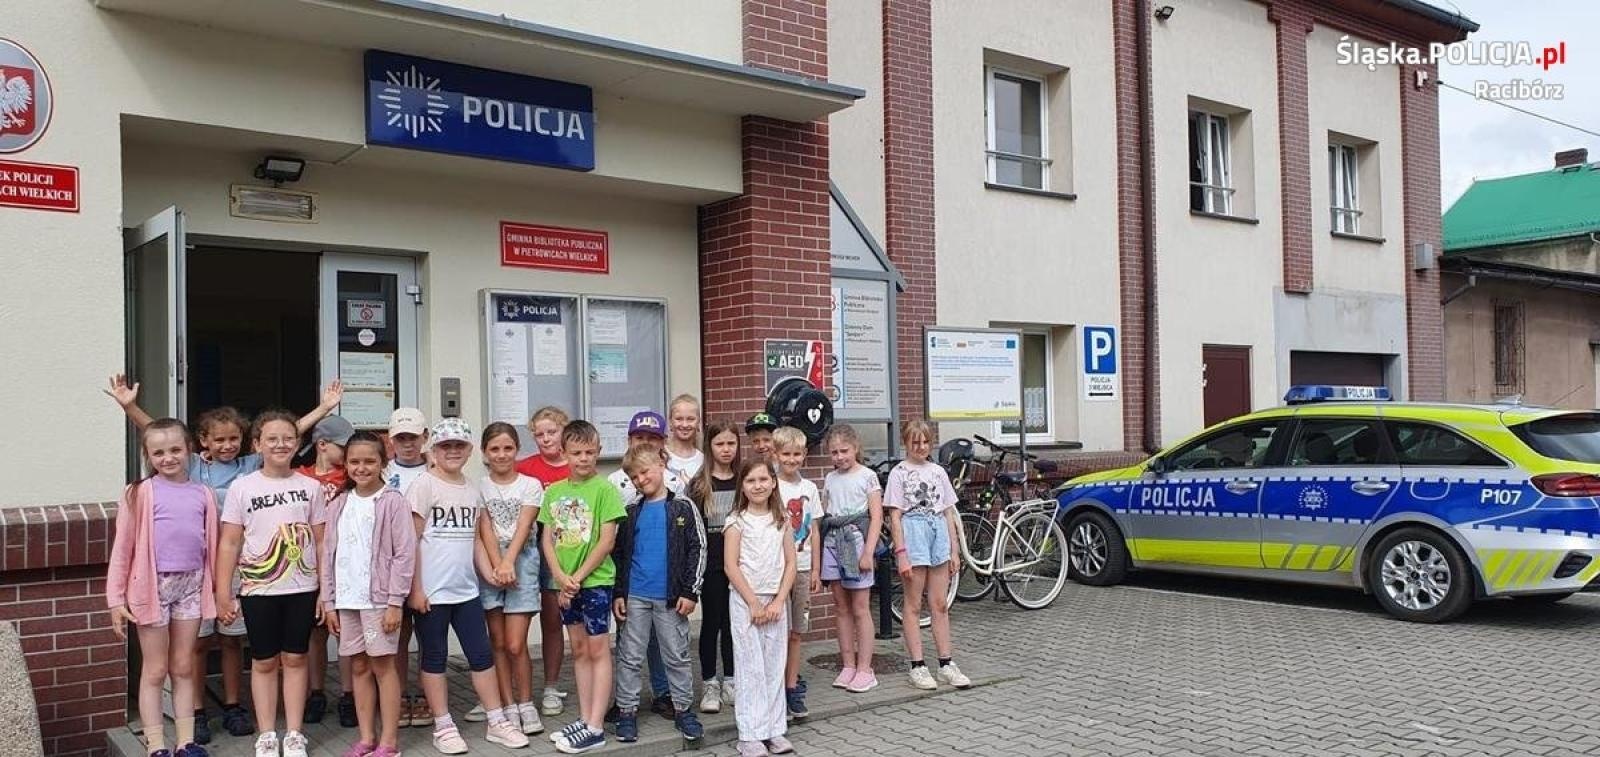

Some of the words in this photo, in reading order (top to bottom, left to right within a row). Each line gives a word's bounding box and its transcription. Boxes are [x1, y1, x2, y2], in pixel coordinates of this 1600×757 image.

[463, 95, 585, 141] POLICJA
[13, 171, 53, 185] POLICJI
[19, 187, 72, 201] WIELKICH
[506, 233, 533, 244] GMINNA
[534, 236, 569, 247] BIBLIOTEKA
[570, 239, 603, 250] PUBLICZNA
[513, 247, 520, 256] W
[521, 247, 568, 260] PIETROWICACH
[569, 251, 598, 262] WIELKICH
[523, 305, 558, 316] POLICJA
[1091, 331, 1112, 371] P
[779, 355, 804, 368] AED
[1347, 386, 1376, 399] POLICJA
[251, 493, 287, 510] BREAK
[1141, 487, 1216, 508] POLICJA
[1481, 488, 1522, 505] P107
